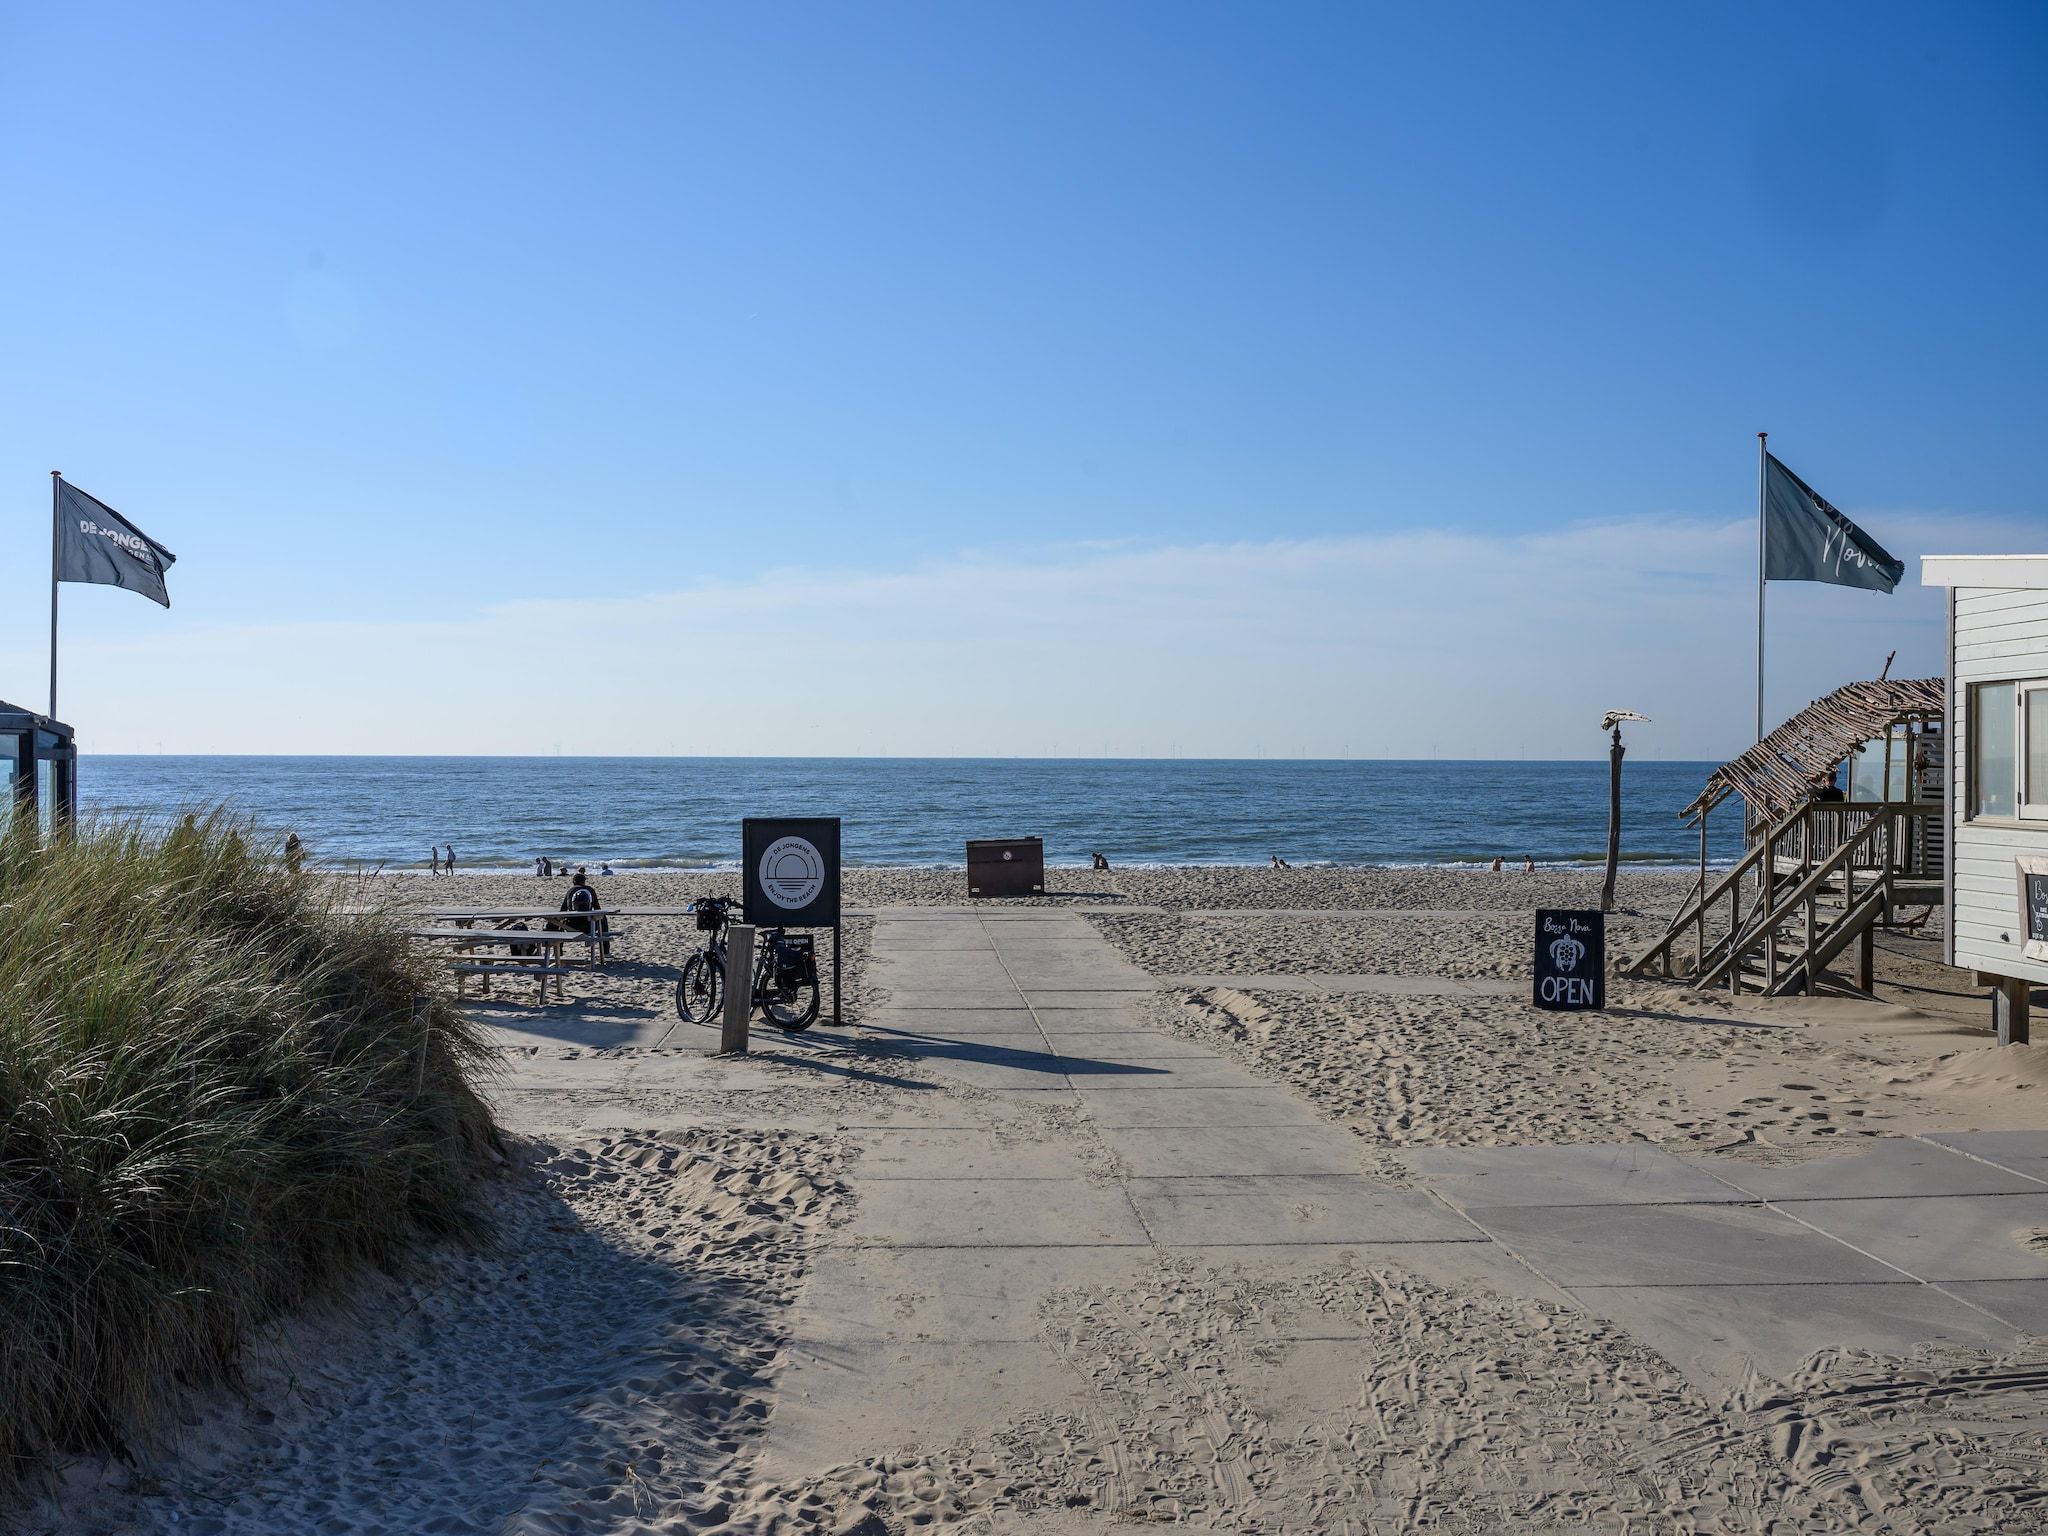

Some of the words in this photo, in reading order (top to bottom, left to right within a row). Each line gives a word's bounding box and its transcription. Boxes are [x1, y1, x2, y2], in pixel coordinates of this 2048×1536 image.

[80, 520, 97, 534] DE
[99, 528, 151, 553] JONGE
[1823, 525, 1881, 577] Nov
[773, 845, 781, 855] DE
[782, 842, 810, 855] JONGENS
[768, 884, 785, 901] ENJOY
[798, 884, 816, 902] BEACH
[1569, 917, 1592, 934] Nova
[1541, 976, 1594, 1005] OPEN
